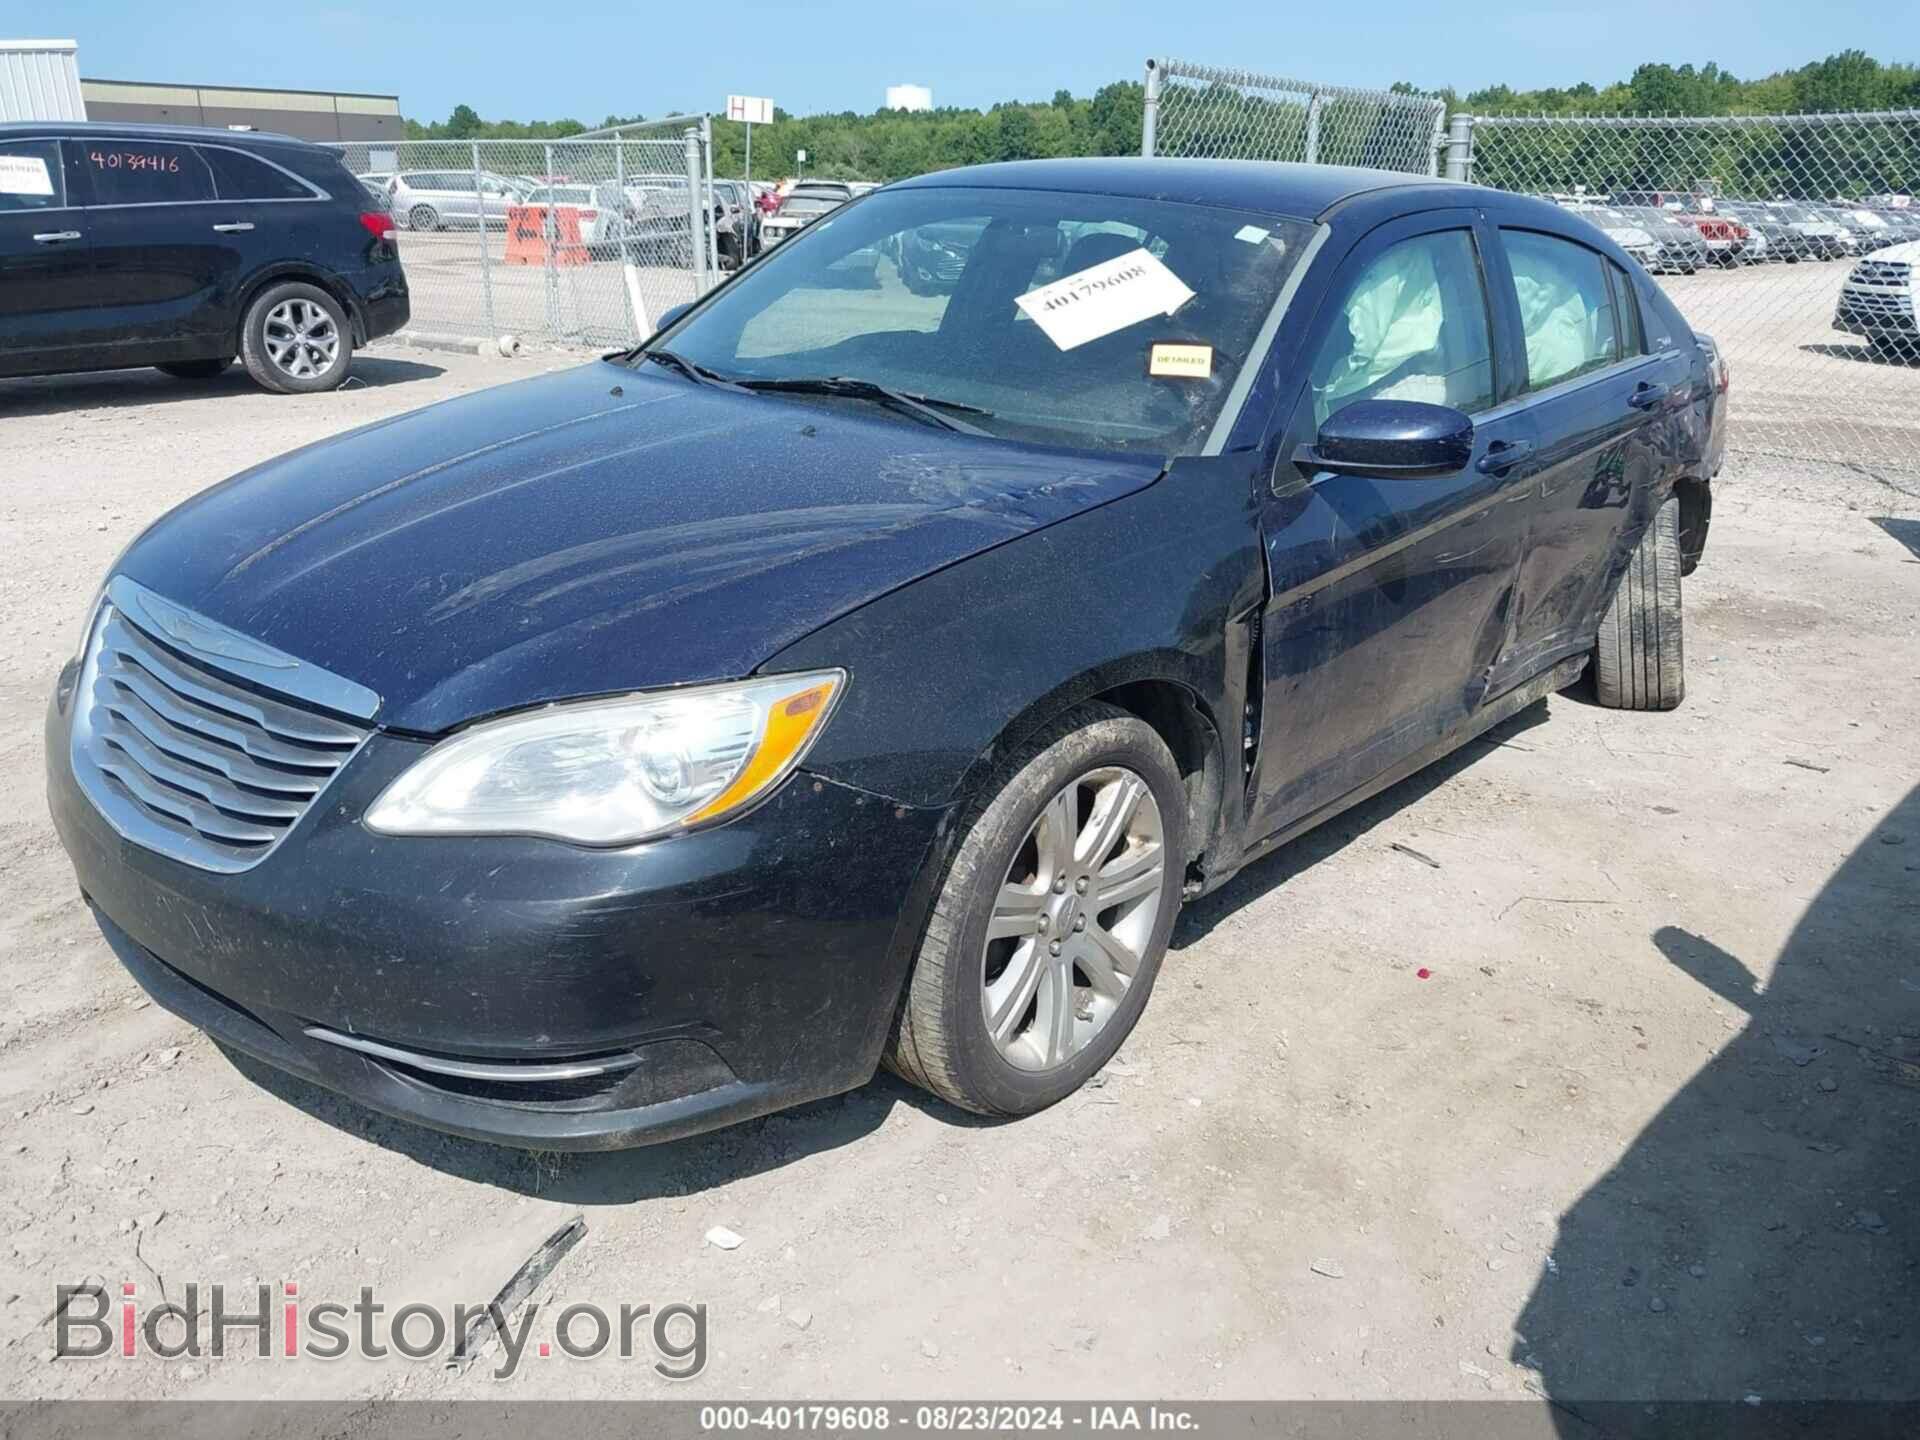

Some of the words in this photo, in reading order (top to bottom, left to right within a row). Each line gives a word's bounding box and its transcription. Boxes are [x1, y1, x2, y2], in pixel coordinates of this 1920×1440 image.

[731, 96, 745, 121] H
[90, 152, 180, 173] 40139416
[1043, 265, 1147, 311] 40179608
